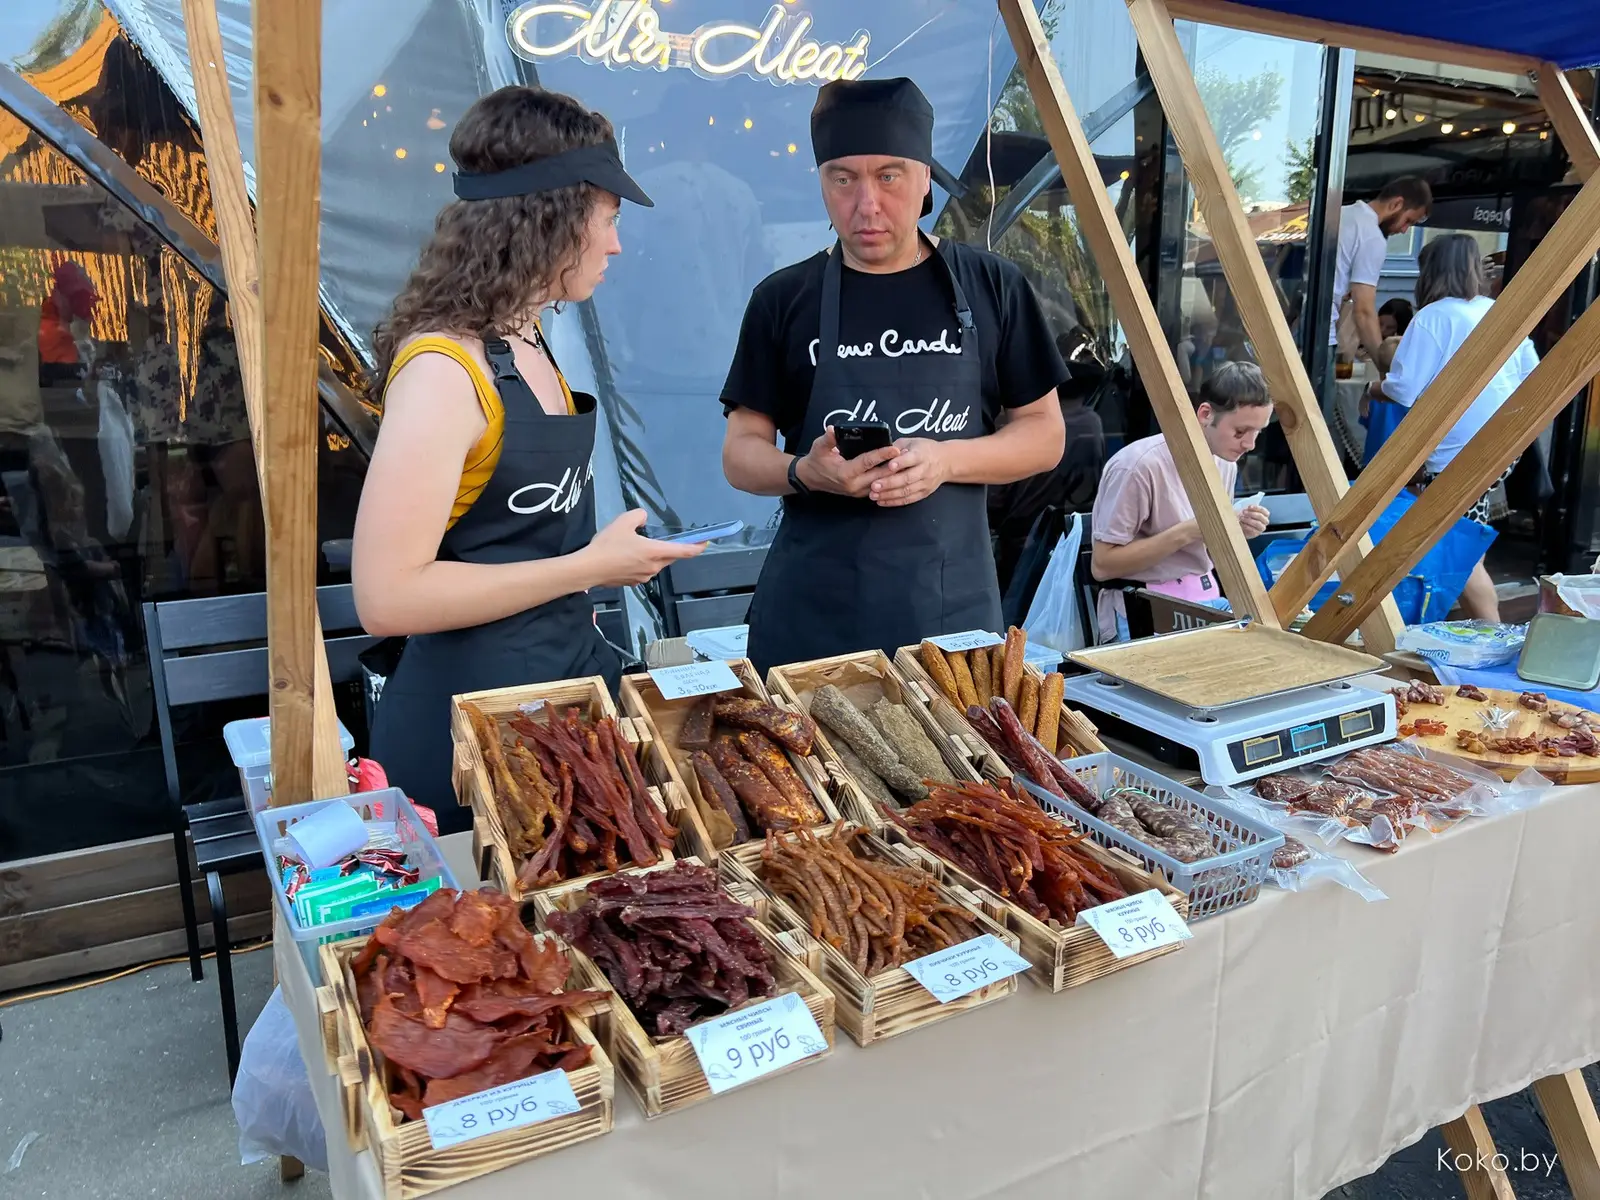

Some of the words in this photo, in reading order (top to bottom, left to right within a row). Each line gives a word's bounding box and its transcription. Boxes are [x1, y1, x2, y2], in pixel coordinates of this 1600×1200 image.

[695, 9, 868, 81] Meat
[880, 328, 962, 358] Cardi
[895, 398, 970, 434] Meat
[1118, 927, 1134, 943] 8
[1134, 916, 1166, 943] руб
[944, 973, 962, 987] 8
[962, 957, 999, 984] руб
[726, 1047, 743, 1069] 9
[748, 1027, 791, 1068] руб
[460, 1113, 478, 1129] 8
[487, 1095, 538, 1127] руб
